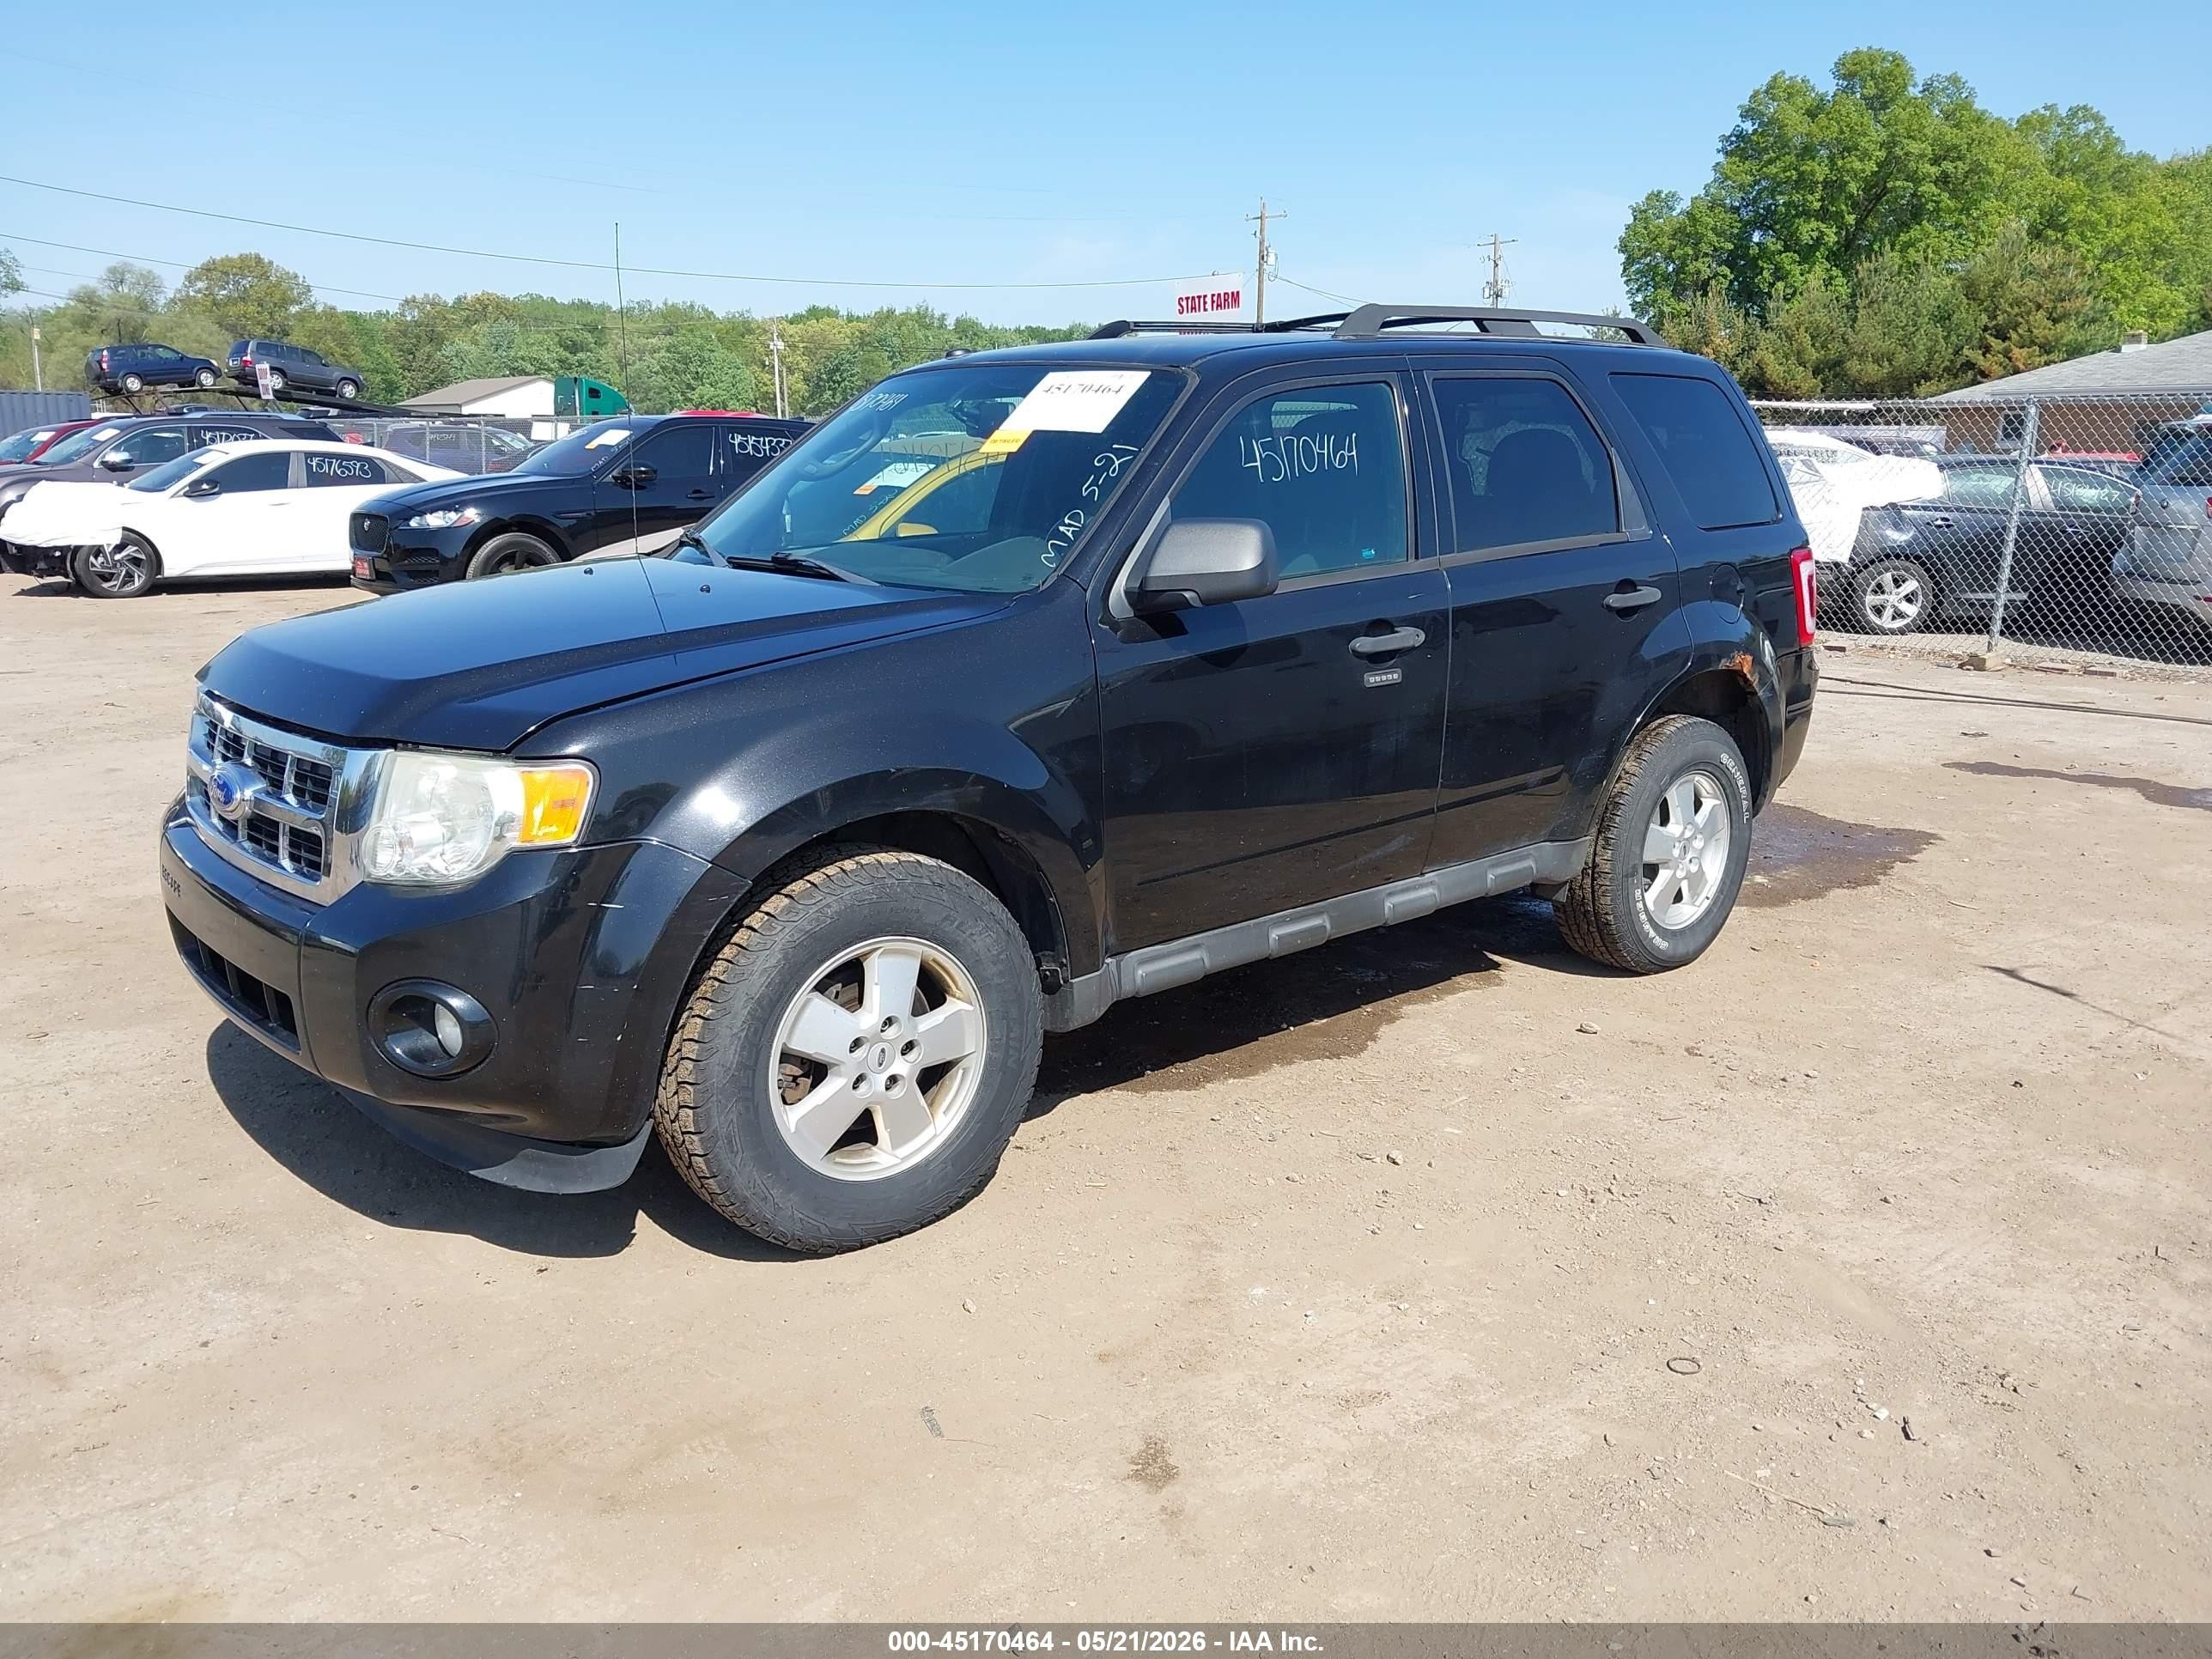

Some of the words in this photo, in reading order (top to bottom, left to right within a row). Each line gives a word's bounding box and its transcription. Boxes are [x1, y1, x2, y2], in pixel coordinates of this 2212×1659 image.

[1177, 294, 1209, 315] STATE
[1211, 290, 1241, 311] FARM
[1042, 383, 1127, 395] 45170464
[307, 456, 372, 478] 45176593
[1238, 432, 1359, 483] 45170464
[1040, 509, 1085, 568] MAD
[1082, 444, 1140, 501] 5-21
[1719, 752, 1750, 824] GENERAL
